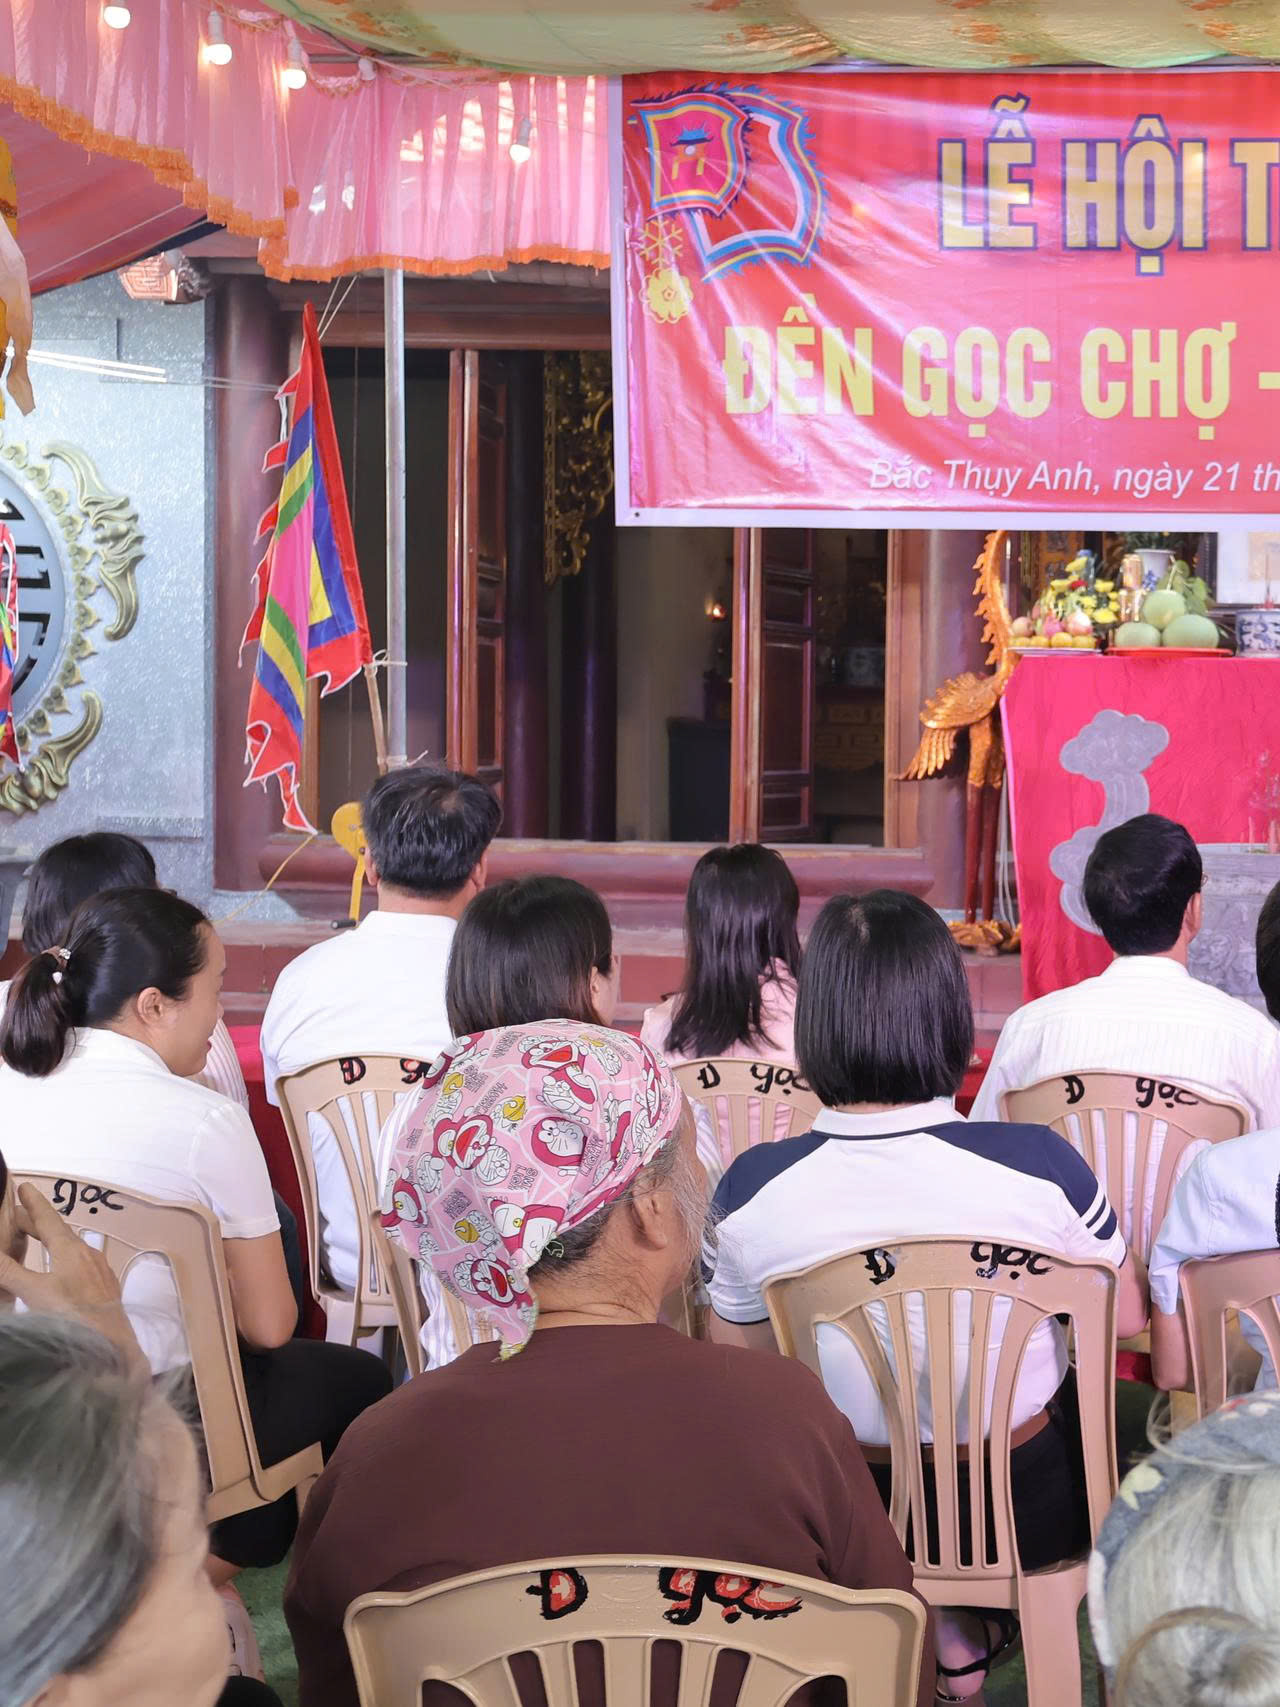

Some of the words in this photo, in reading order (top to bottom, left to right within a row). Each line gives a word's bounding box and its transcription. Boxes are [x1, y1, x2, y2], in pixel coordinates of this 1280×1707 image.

[938, 92, 1037, 251] LỄ
[1062, 113, 1208, 277] HỘI
[723, 293, 874, 416] ĐỀN
[902, 326, 1052, 439] GỌC
[1080, 321, 1237, 440] CHỢ
[869, 455, 933, 490] Bắc
[943, 459, 1027, 497] Thụy
[1028, 461, 1100, 495] Anh,
[1112, 461, 1193, 498] ngày
[1203, 462, 1241, 492] 21
[697, 1061, 721, 1089] Đ
[1062, 1075, 1085, 1104] Đ
[1136, 1077, 1199, 1108] gọc
[52, 1178, 124, 1216] gọc
[859, 1248, 897, 1285] Đ
[970, 1242, 1055, 1279] gọc
[525, 1567, 588, 1620] Đ
[658, 1567, 802, 1625] gọc
